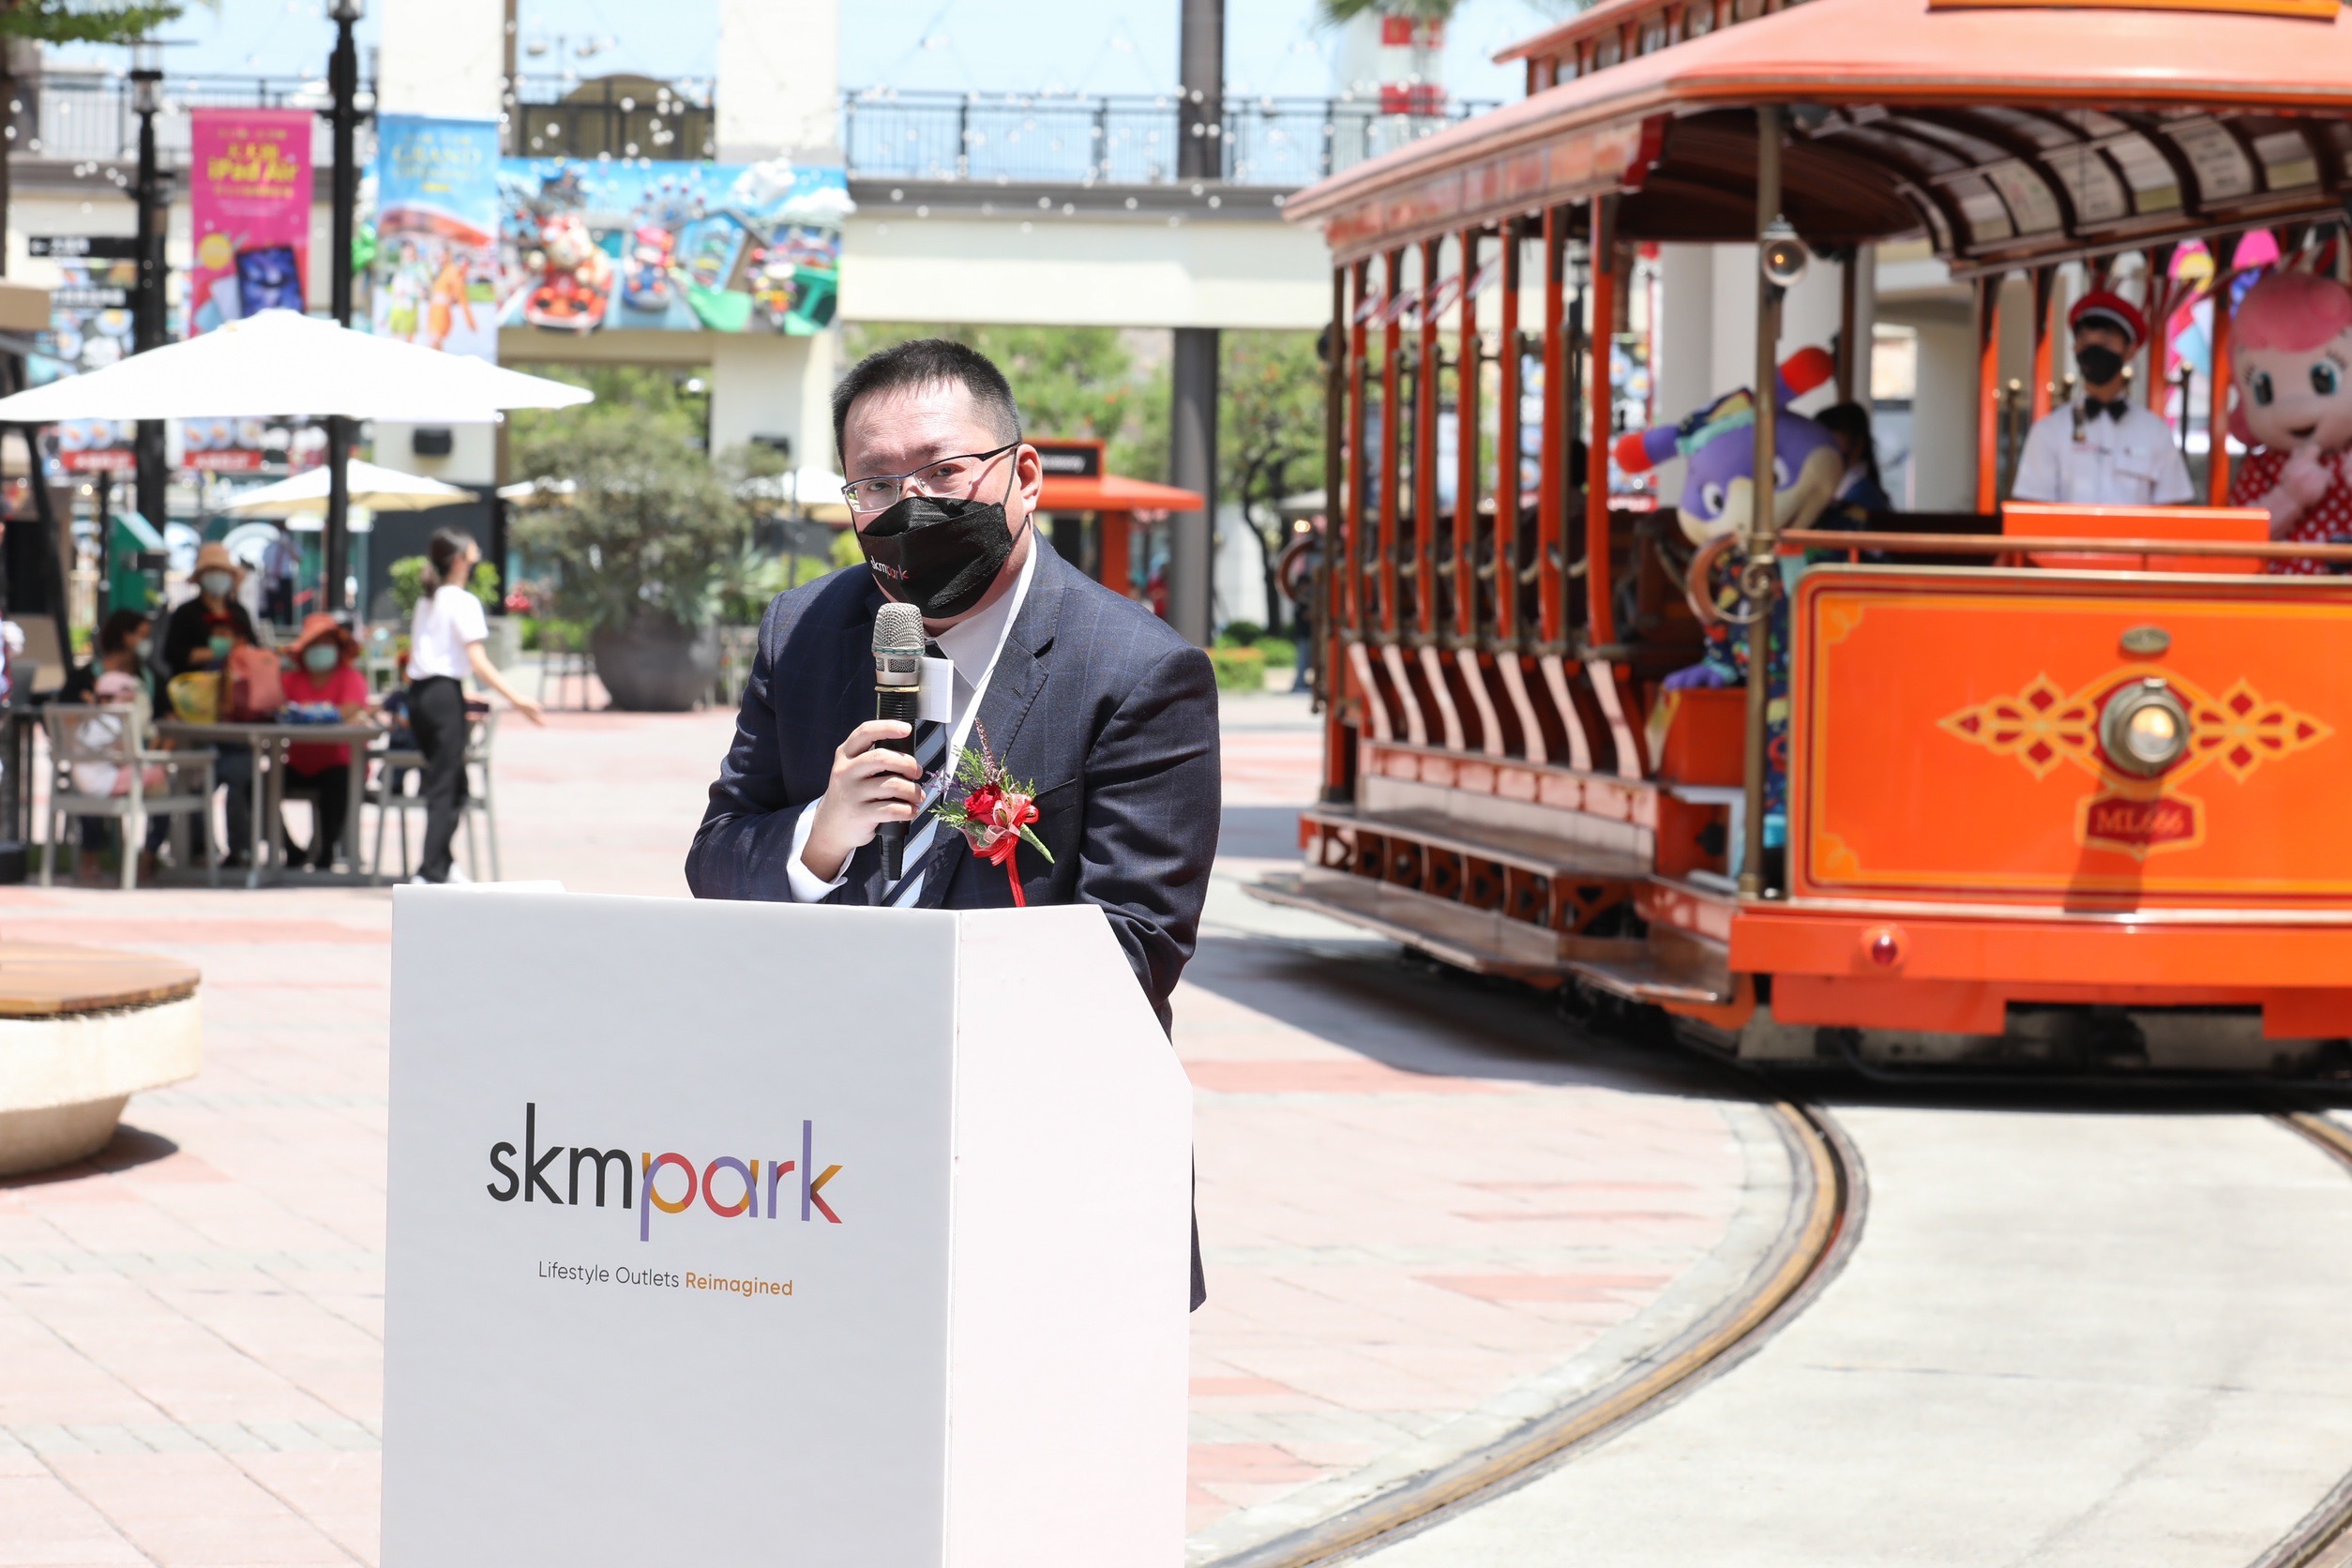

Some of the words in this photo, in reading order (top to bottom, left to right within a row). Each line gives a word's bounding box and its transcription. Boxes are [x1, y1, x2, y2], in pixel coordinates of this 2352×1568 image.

[207, 158, 261, 182] iPad
[263, 160, 299, 183] Air
[870, 555, 910, 580] skmpark
[486, 1102, 844, 1243] skmpark
[538, 1260, 610, 1285] Lifestyle
[615, 1266, 680, 1288] Outlets
[685, 1272, 793, 1297] Reimagined
